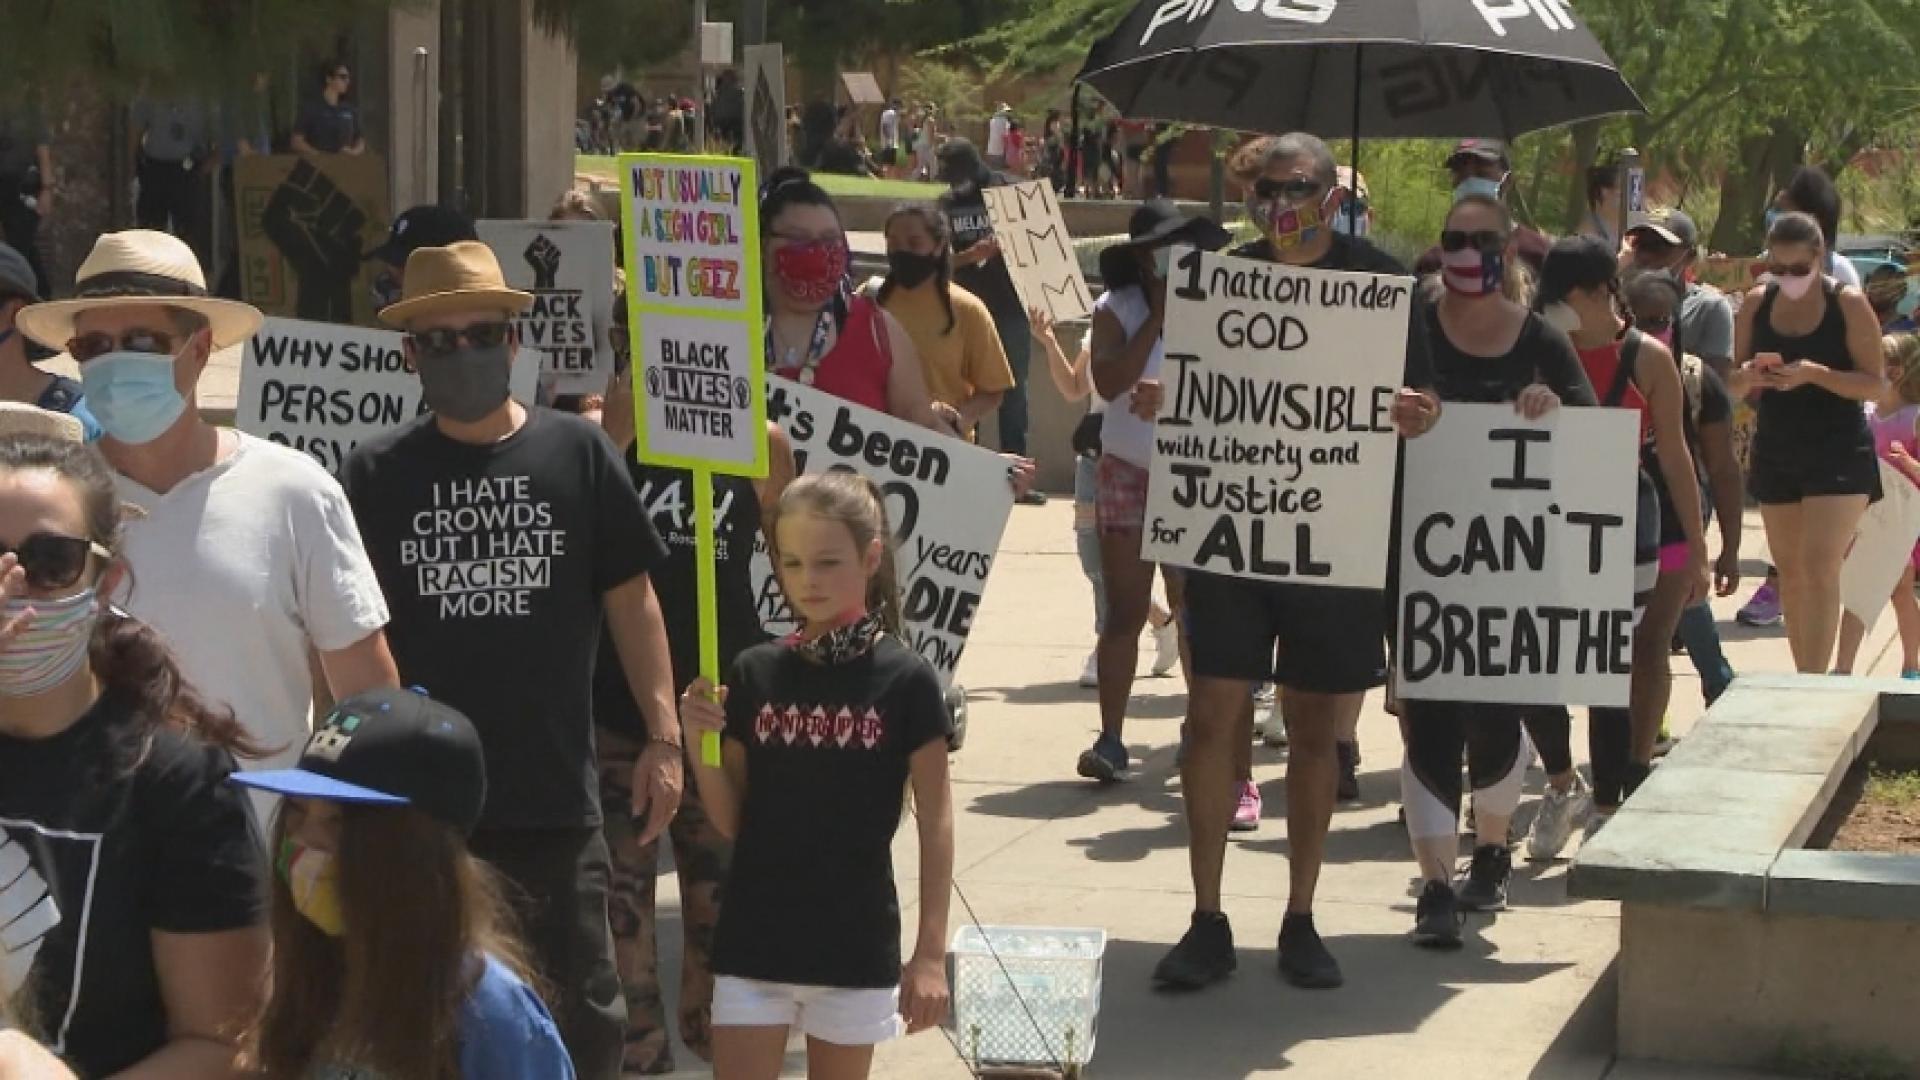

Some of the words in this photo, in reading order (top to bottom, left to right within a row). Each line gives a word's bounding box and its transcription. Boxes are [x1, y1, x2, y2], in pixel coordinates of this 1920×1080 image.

[632, 168, 665, 200] NOT
[667, 169, 741, 207] USUALLY
[641, 206, 652, 238] A
[654, 208, 694, 244] SIGN
[696, 210, 739, 246] GIRL
[643, 255, 682, 297] BUT
[686, 256, 741, 299] GEEZ
[1175, 250, 1208, 302] 1
[1209, 265, 1311, 306] nation
[1320, 276, 1407, 311] under
[252, 333, 334, 368] WHY
[1216, 309, 1309, 351] GOD
[661, 338, 730, 371] BLACK
[259, 379, 403, 426] PERSON
[664, 368, 731, 409] LIVES
[1158, 353, 1394, 432] INDIVISIBLE
[664, 403, 734, 439] MATTER
[828, 405, 949, 486] been
[1157, 435, 1204, 460] with
[1208, 438, 1303, 482] Liberty
[1309, 441, 1360, 466] and
[1488, 428, 1552, 490] I
[432, 482, 441, 507] I
[450, 475, 531, 506] HATE
[1170, 463, 1322, 515] Justice
[412, 502, 553, 536] CROWDS
[1413, 502, 1624, 577] CAN'T
[400, 535, 462, 566] BUT
[472, 533, 480, 560] I
[488, 529, 567, 557] HATE
[907, 534, 991, 580] years
[1150, 516, 1188, 545] for
[1193, 513, 1332, 577] ALL
[420, 557, 549, 594] RACISM
[438, 589, 532, 621] MORE
[902, 575, 981, 637] DIE
[1402, 591, 1634, 683] BREATHE
